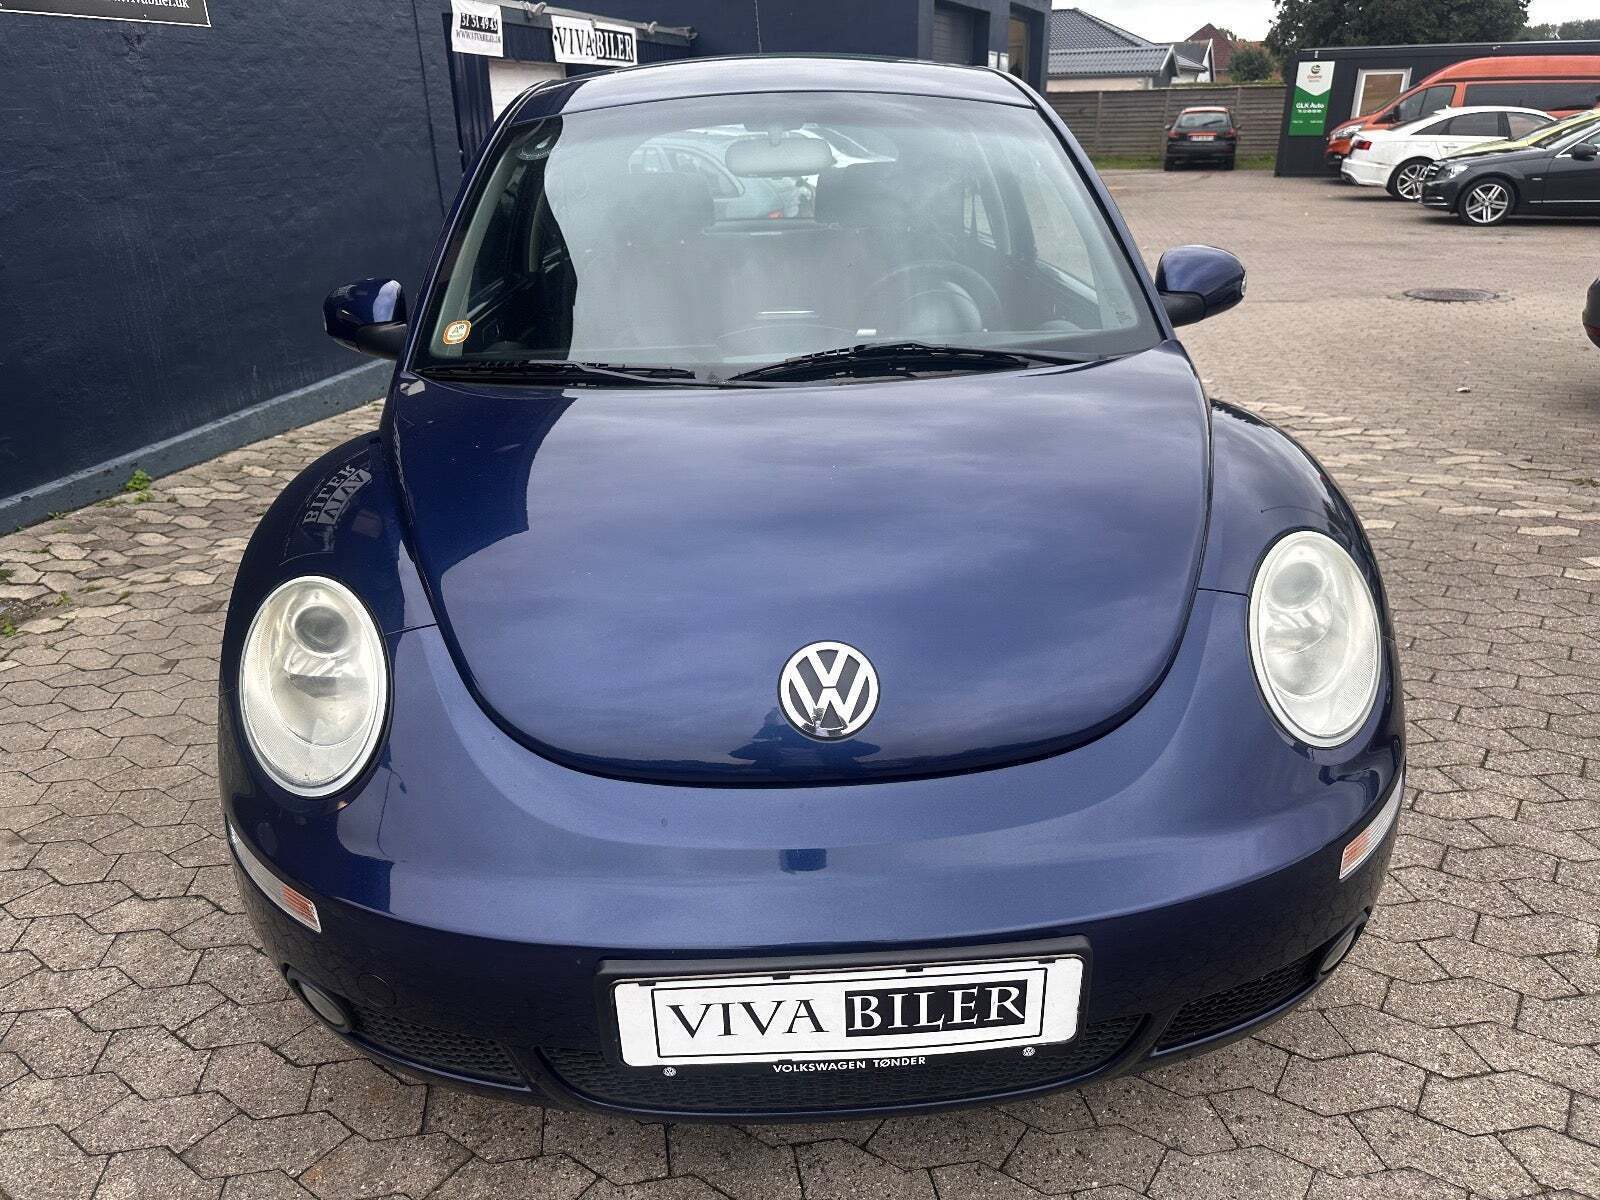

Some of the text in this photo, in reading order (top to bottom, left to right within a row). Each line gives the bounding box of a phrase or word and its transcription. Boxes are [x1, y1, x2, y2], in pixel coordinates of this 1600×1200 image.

[556, 26, 635, 61] VIVA BILER
[665, 985, 1025, 1039] VIVA BILER
[773, 1056, 927, 1073] VOLKSWAGEN TØNDER
